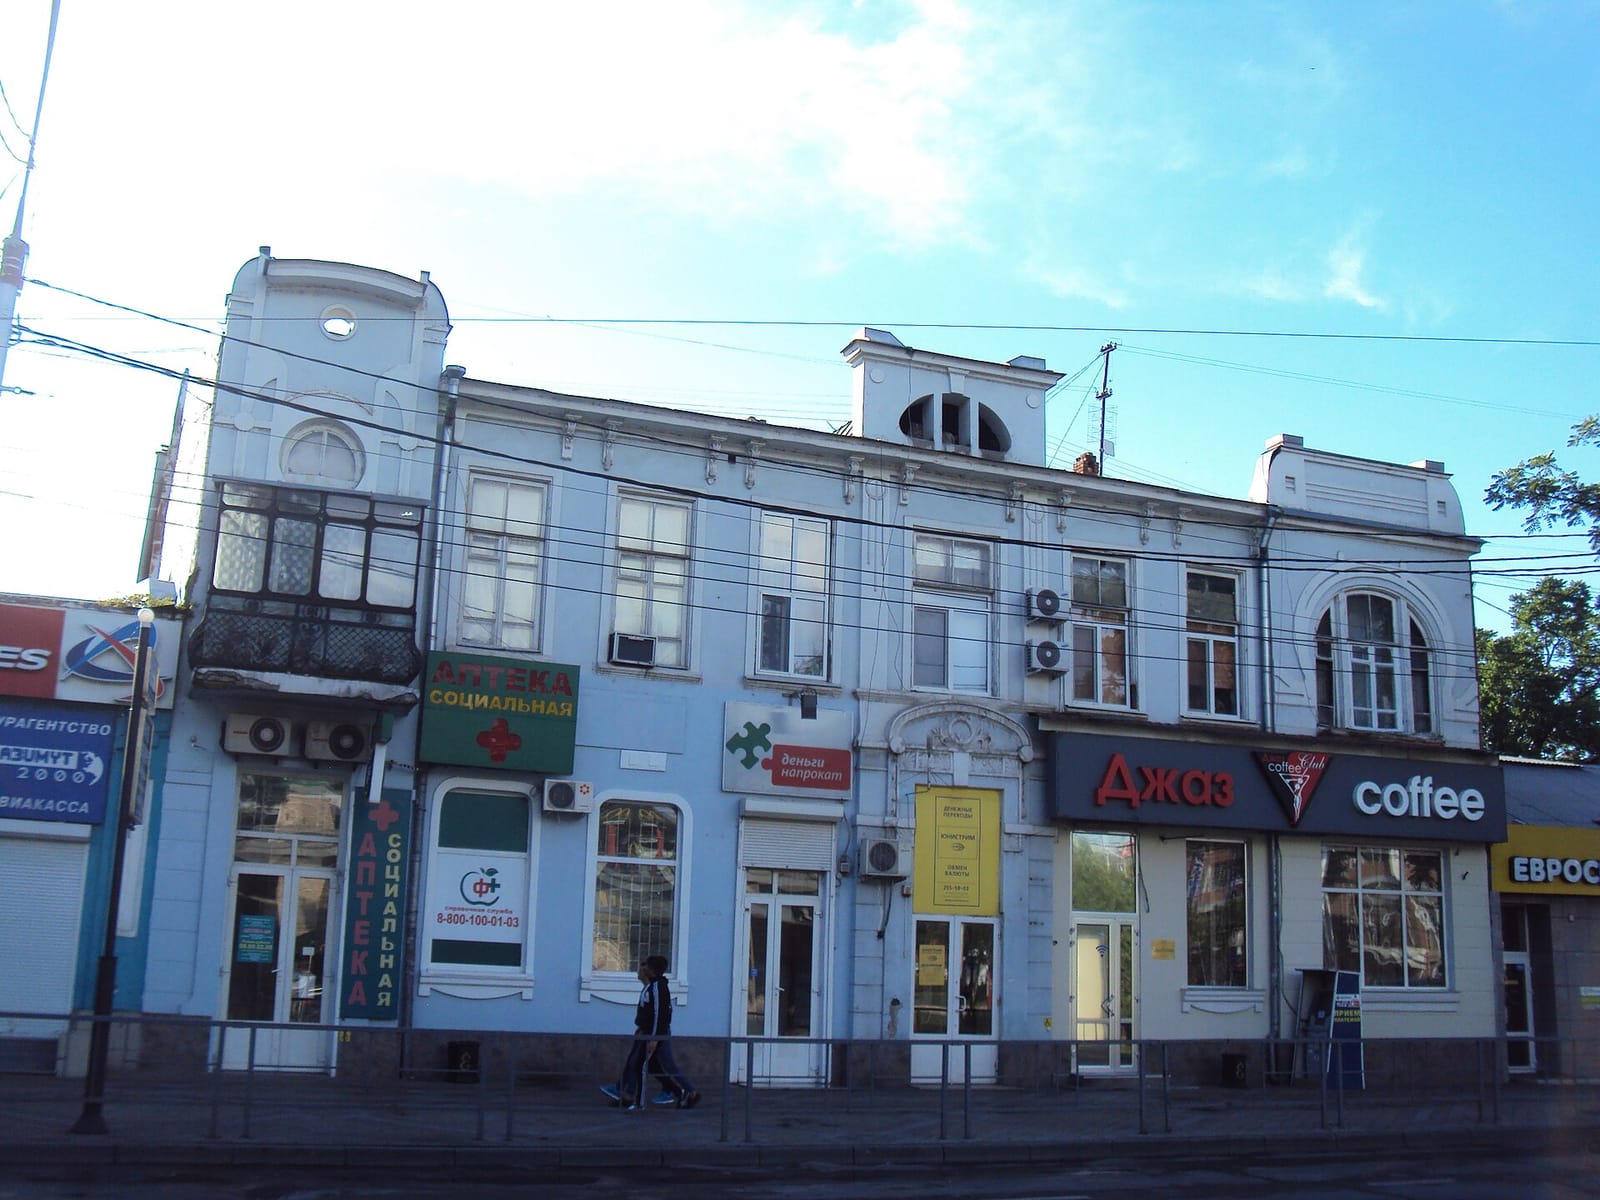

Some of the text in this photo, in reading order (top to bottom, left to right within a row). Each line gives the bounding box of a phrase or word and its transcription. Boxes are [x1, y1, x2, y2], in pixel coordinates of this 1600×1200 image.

[432, 660, 573, 697] АПТЕКА
[429, 689, 573, 716] СОЦИАЛЬНАЯ
[782, 753, 824, 768] деньги
[1267, 761, 1302, 774] coffee
[1298, 752, 1325, 769] Club
[16, 767, 86, 784] 2000
[781, 769, 842, 781] напрокат
[1096, 751, 1235, 808] Джаз
[1353, 775, 1485, 821] coffee
[1512, 856, 1600, 885] ЕВРОС
[348, 832, 377, 1006] АПТЕКА
[376, 833, 402, 1007] СОЦИАЛЬНАЯ
[437, 913, 519, 928] 8-800-100-01-03
